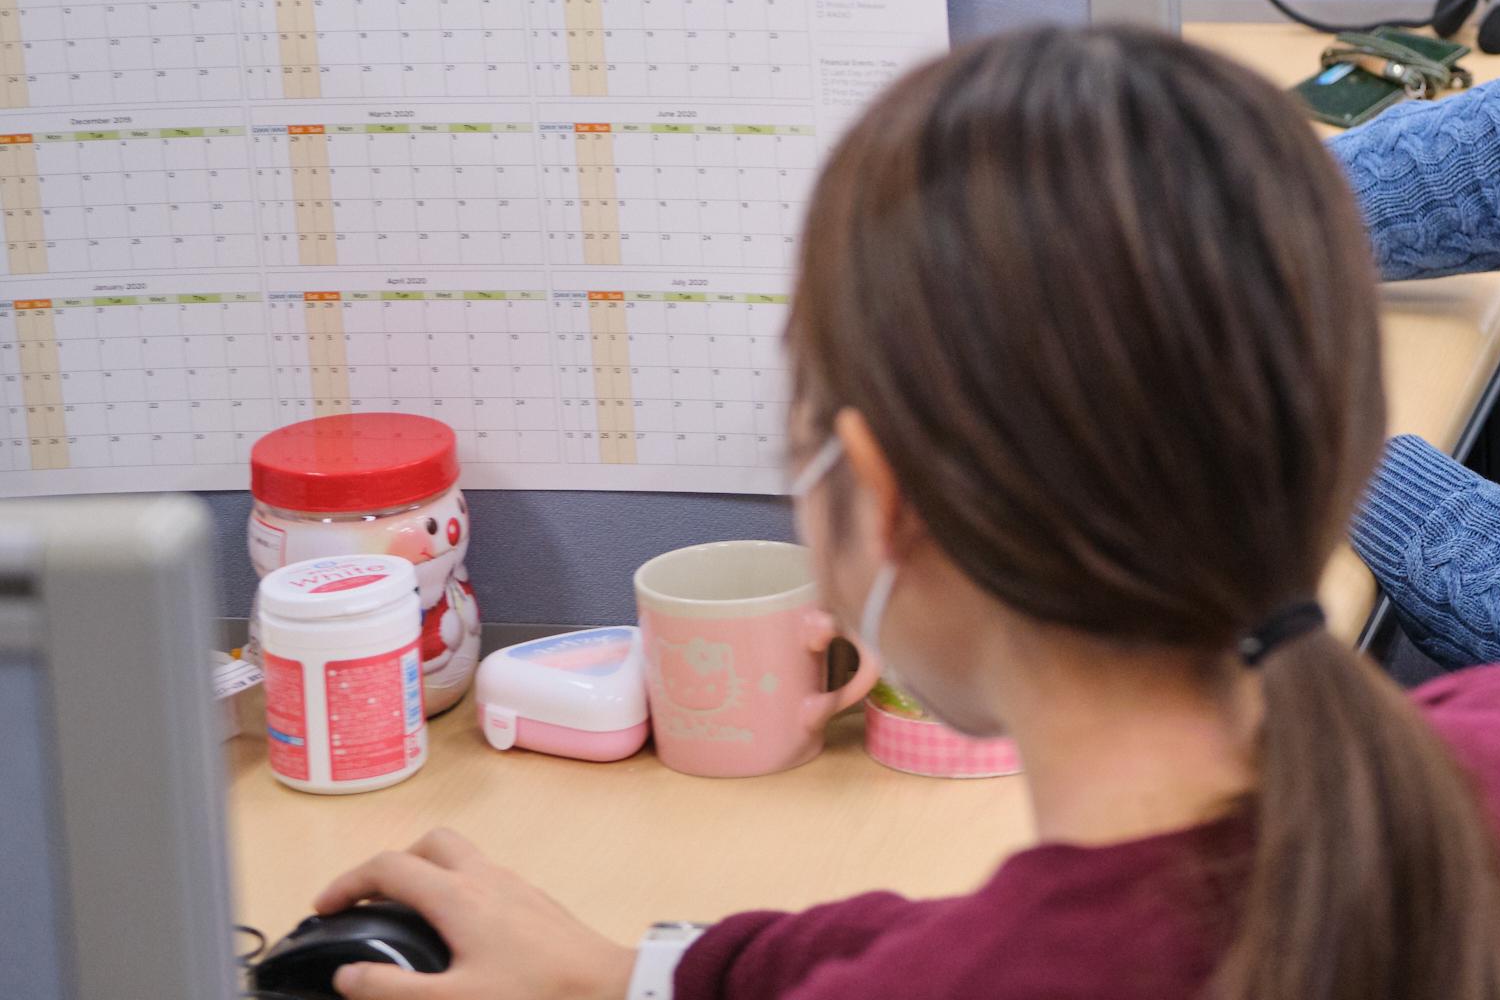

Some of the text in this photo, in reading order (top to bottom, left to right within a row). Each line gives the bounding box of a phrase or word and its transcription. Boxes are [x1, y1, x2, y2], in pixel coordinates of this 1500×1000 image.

[394, 110, 415, 118] 2020
[657, 110, 697, 118] June 2020
[70, 118, 111, 126] December
[387, 277, 427, 285] April 2020
[671, 279, 709, 287] July 2020
[93, 284, 124, 292] January
